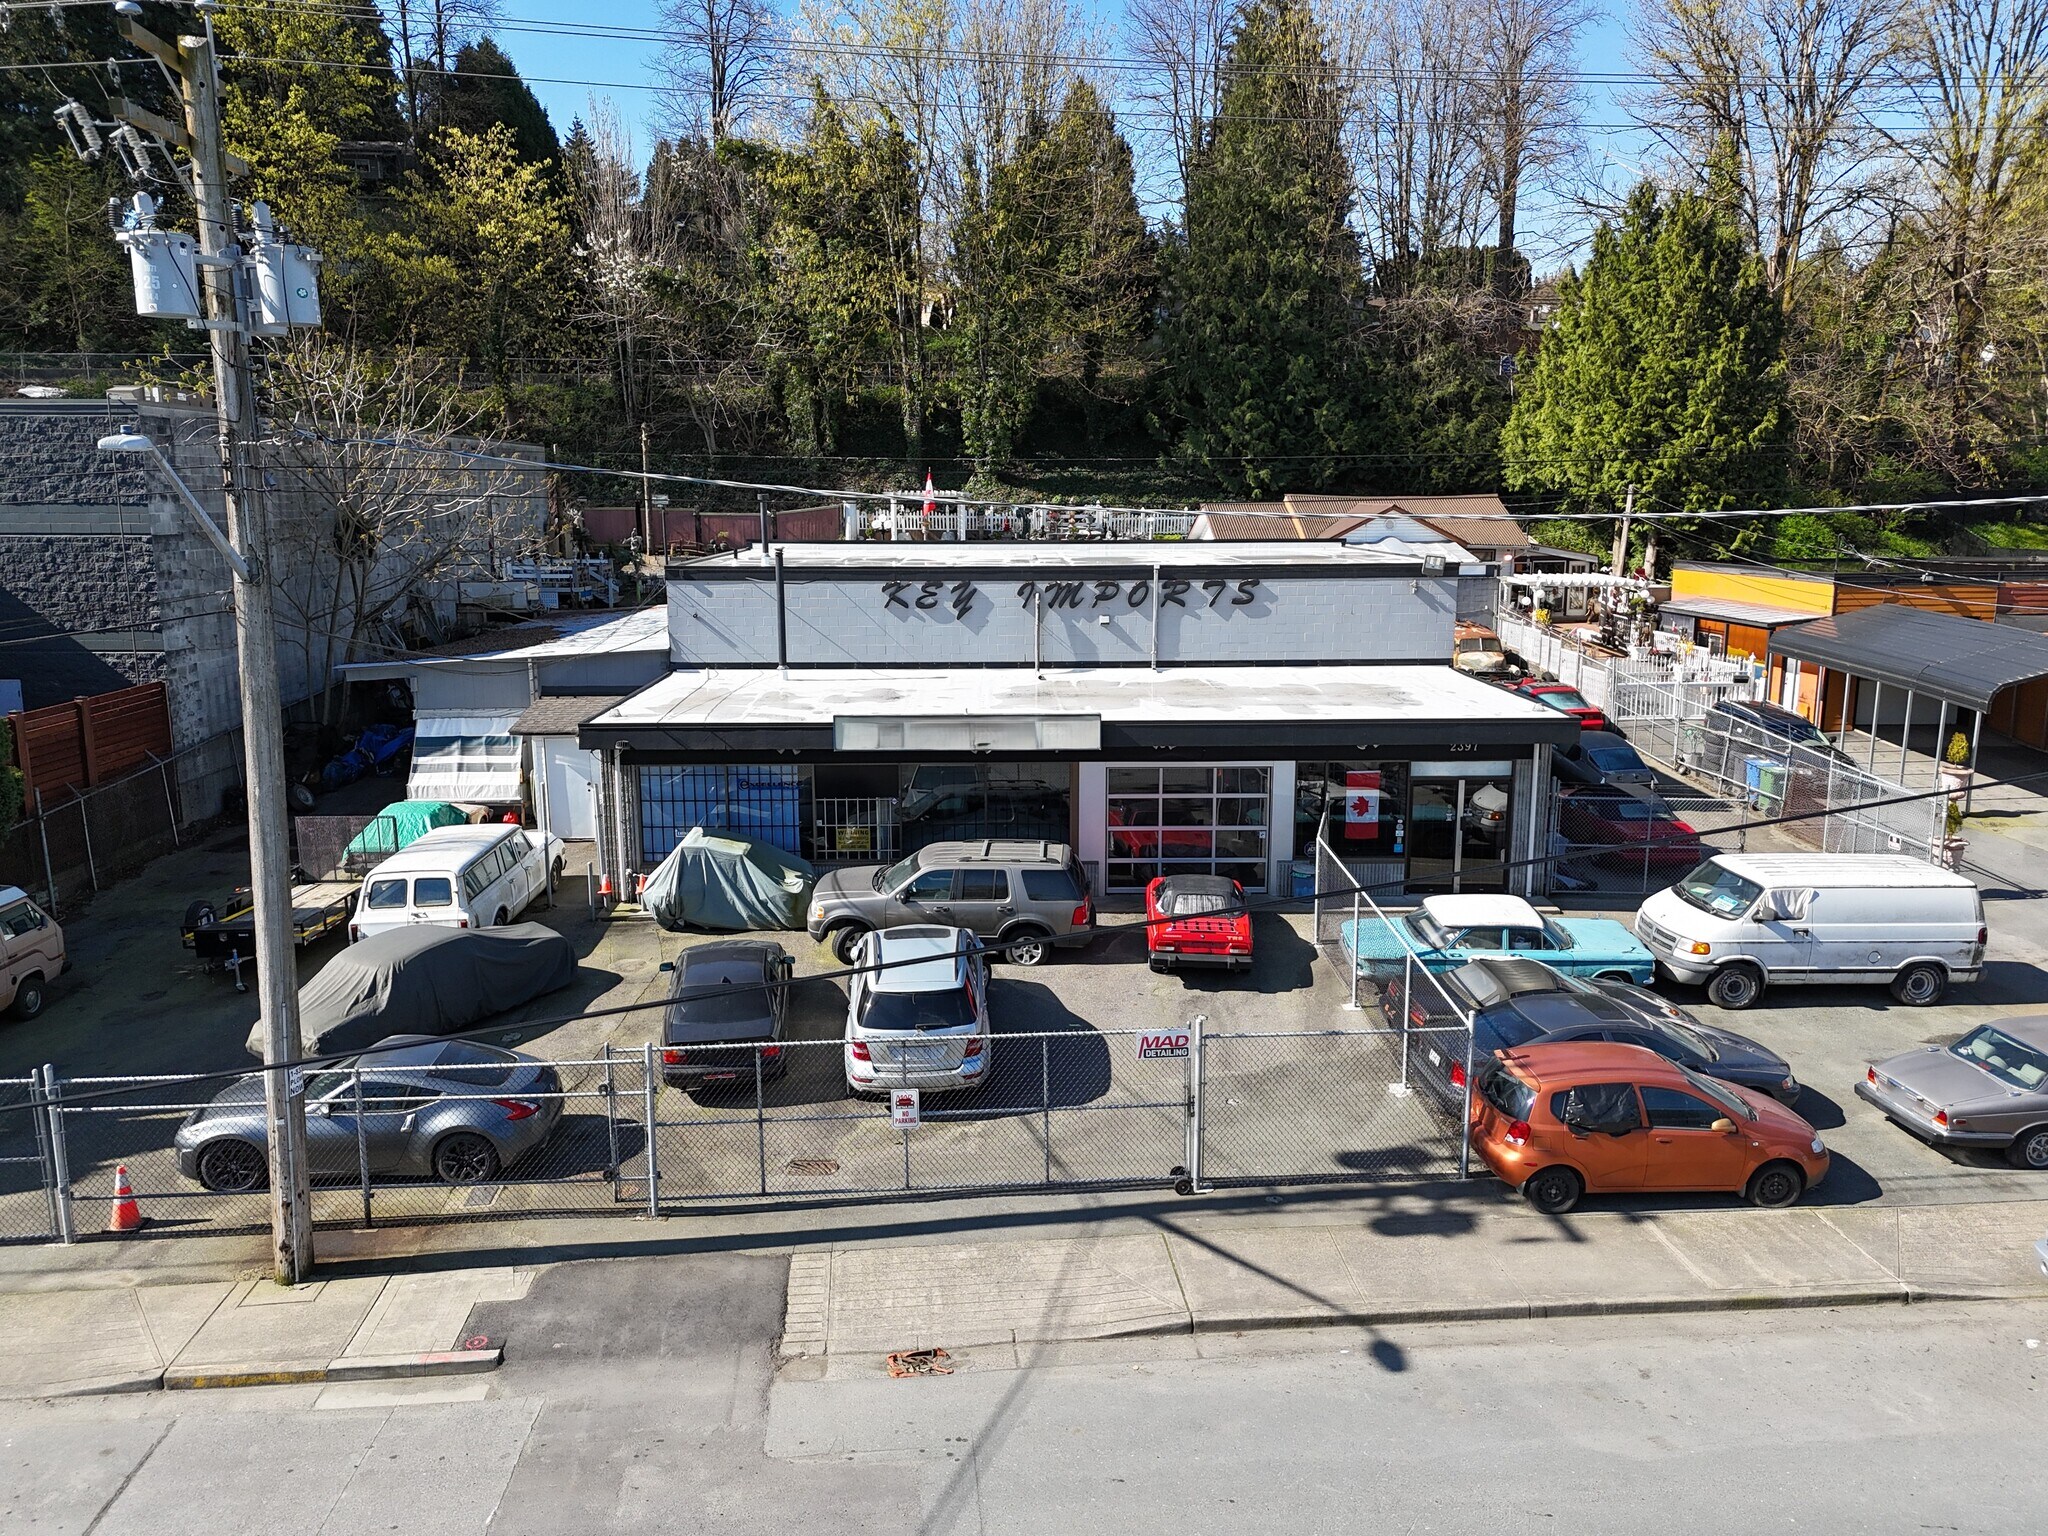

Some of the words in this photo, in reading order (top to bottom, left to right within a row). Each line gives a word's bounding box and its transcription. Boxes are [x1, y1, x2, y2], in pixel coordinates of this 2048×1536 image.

[143, 275, 160, 290] 25
[881, 579, 977, 620] KEY
[1017, 578, 1260, 609] IMPORTS
[1138, 1035, 1190, 1059] MAD
[1145, 1048, 1188, 1058] DETAILING
